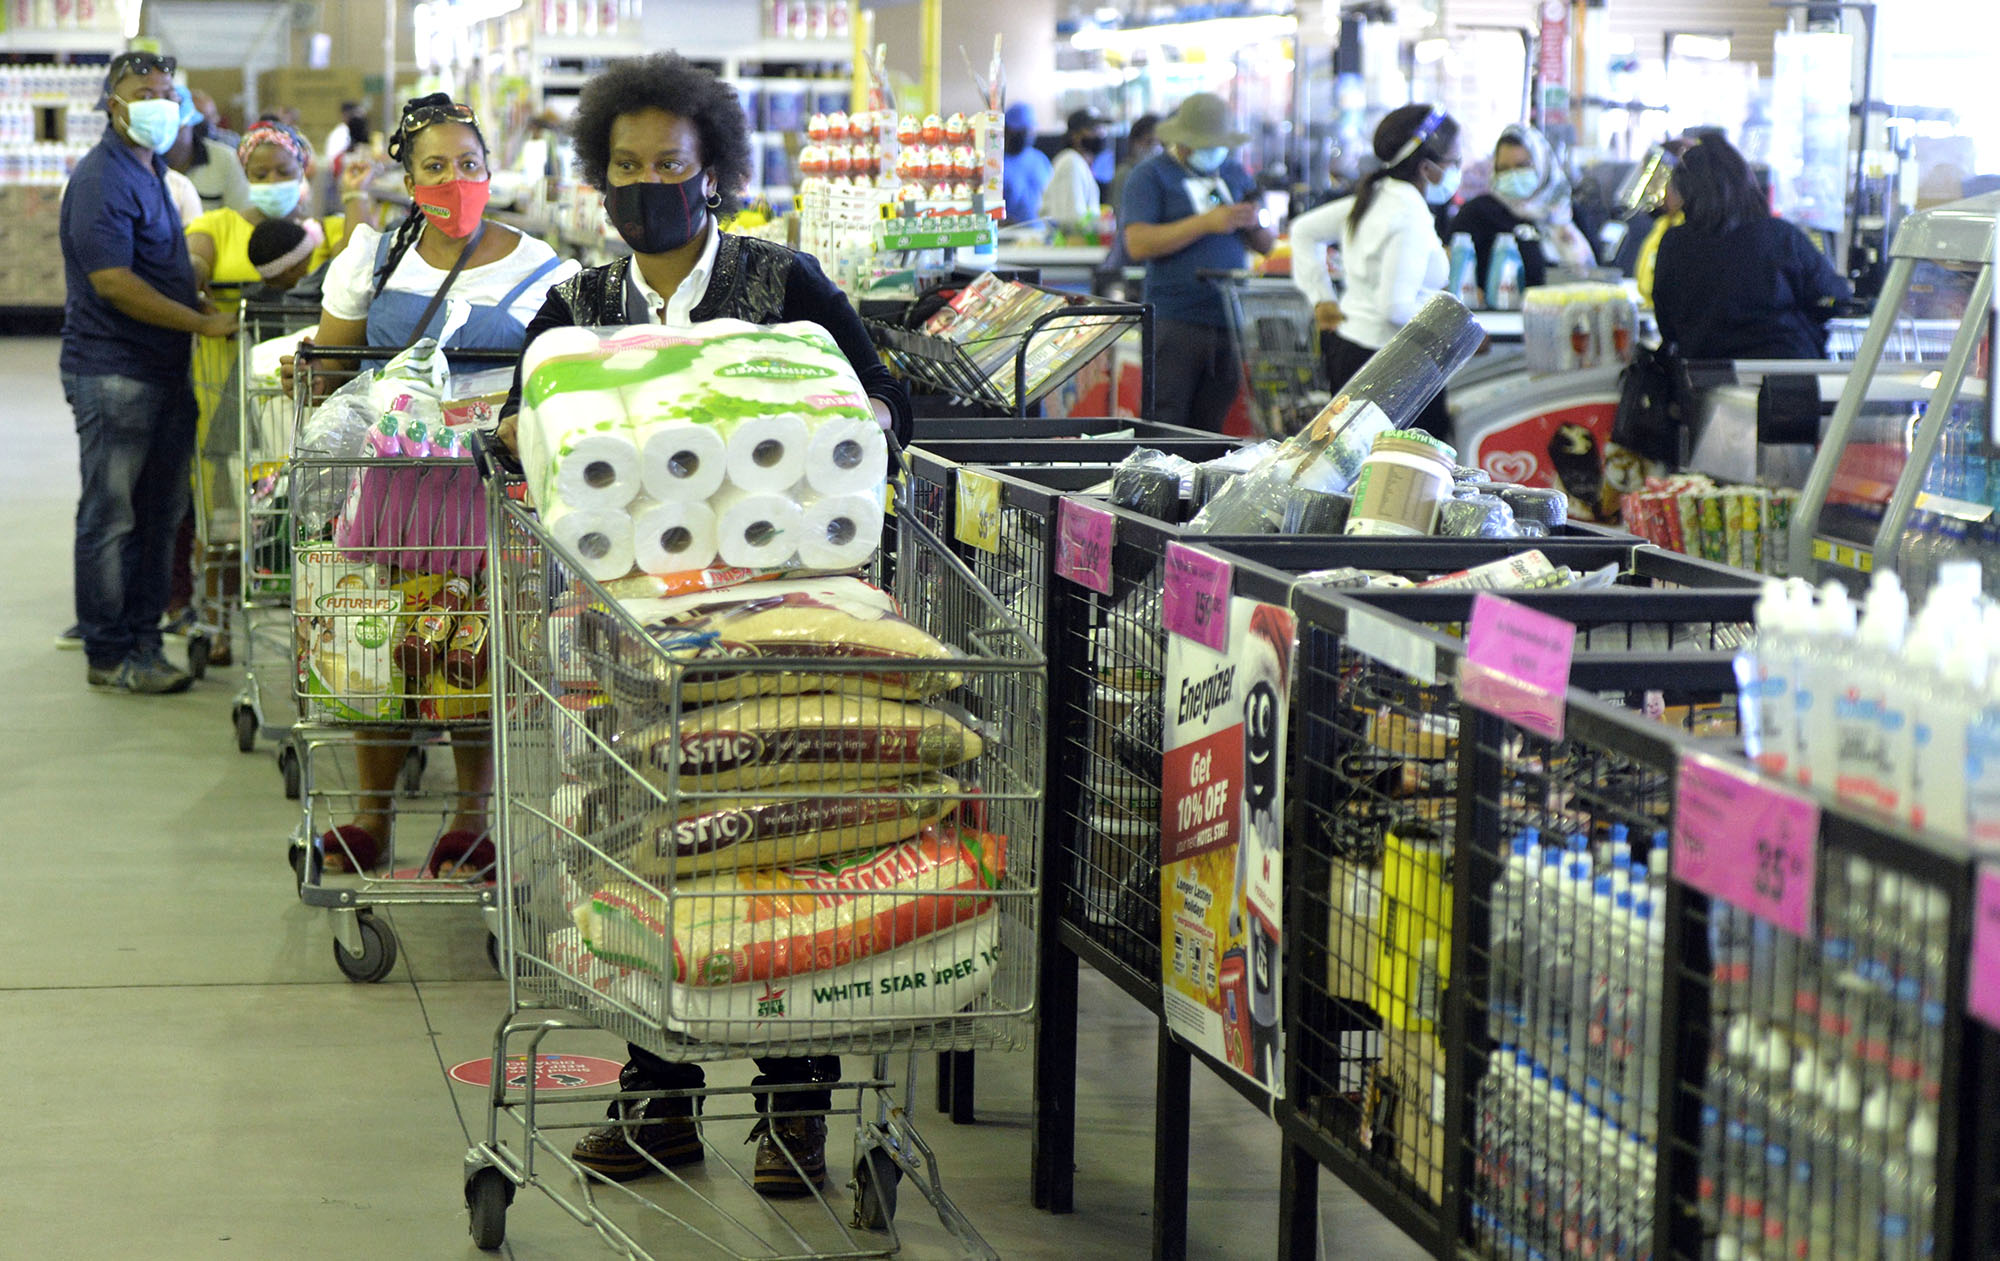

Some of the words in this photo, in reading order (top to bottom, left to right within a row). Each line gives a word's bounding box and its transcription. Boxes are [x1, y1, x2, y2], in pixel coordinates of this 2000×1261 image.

[725, 365, 828, 377] TWINSAVER
[326, 597, 391, 610] FUTURELIFE
[1177, 664, 1236, 726] Energizer
[1190, 749, 1212, 788] Get
[1178, 790, 1203, 832] 10%
[1205, 779, 1229, 821] OFF
[813, 981, 872, 1004] WHITE
[880, 972, 928, 994] STAR
